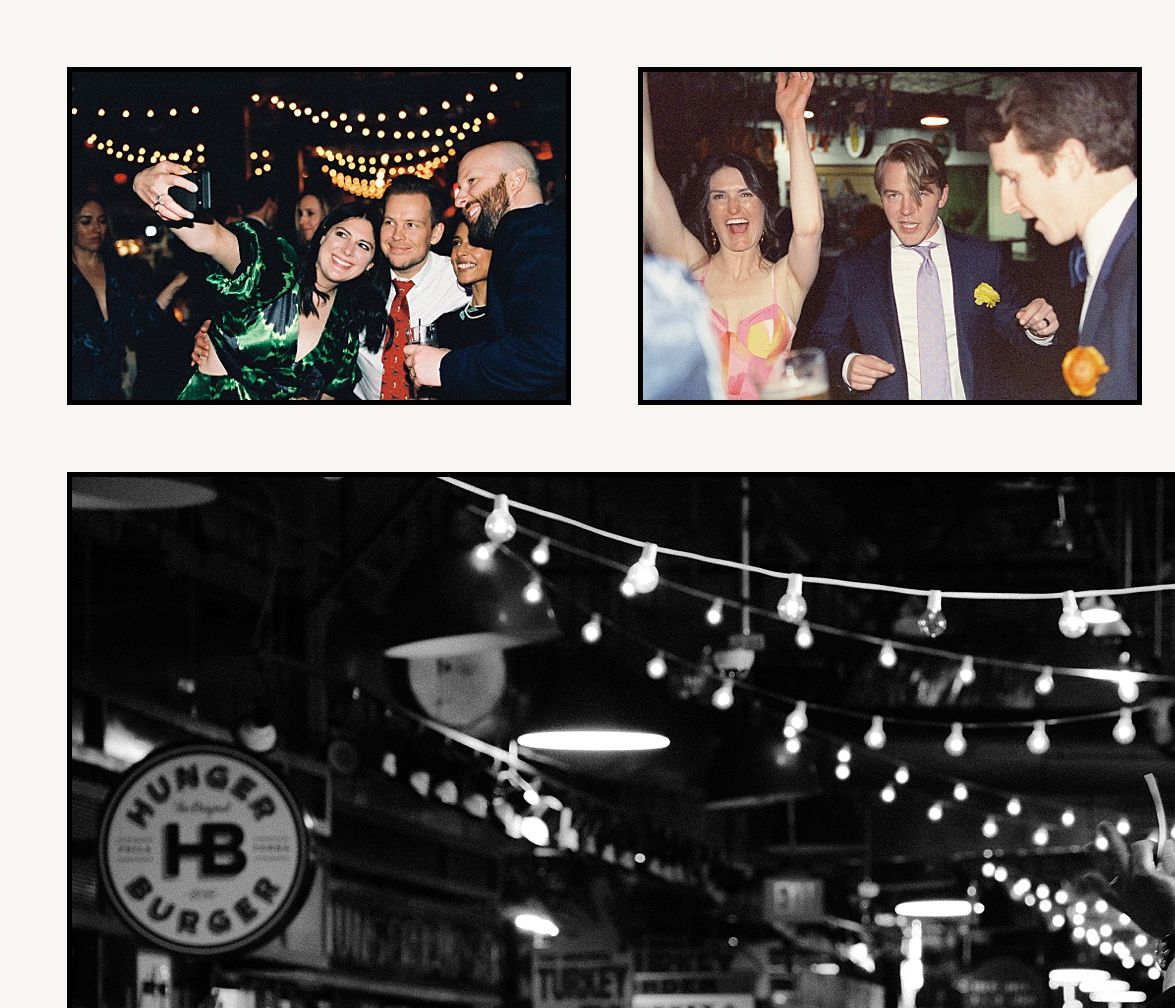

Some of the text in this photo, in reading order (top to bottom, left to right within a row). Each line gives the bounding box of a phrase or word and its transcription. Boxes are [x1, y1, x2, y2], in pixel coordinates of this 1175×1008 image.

[126, 764, 275, 829] HUNGER
[163, 822, 247, 880] HB
[125, 874, 281, 935] BURGER
[538, 966, 628, 1000] TURKEY
